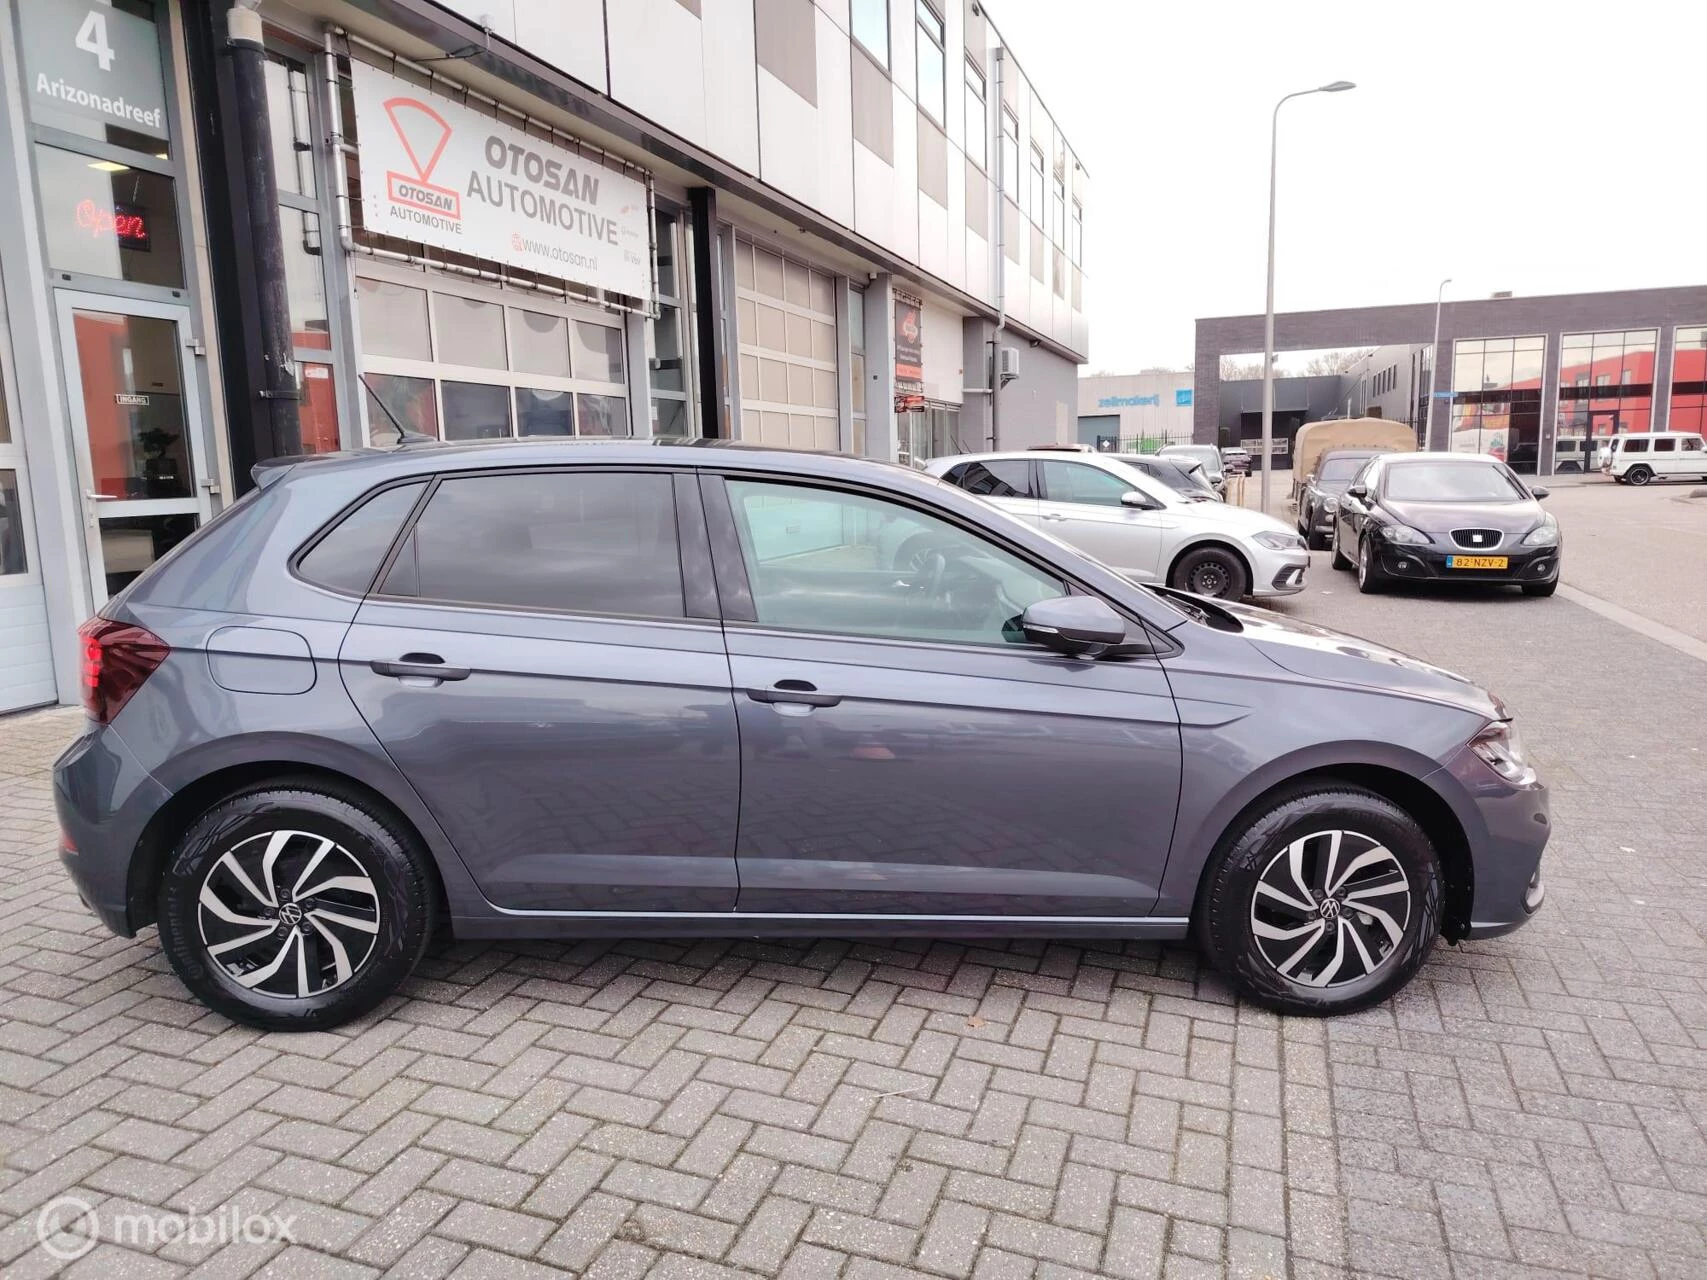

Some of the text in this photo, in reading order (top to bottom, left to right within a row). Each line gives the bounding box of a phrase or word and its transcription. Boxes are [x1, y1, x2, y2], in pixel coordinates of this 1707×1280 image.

[75, 9, 116, 72] 4
[36, 72, 162, 129] Arizonadreef
[484, 135, 600, 206] OTOSAN
[398, 184, 453, 211] OTOSAN
[466, 170, 619, 246] AUTOMOTIVE
[76, 198, 146, 238] Open
[389, 205, 463, 235] AUTOMOTIVE
[522, 239, 598, 272] www.otosan.nl
[1456, 558, 1504, 568] 82-NZV-2
